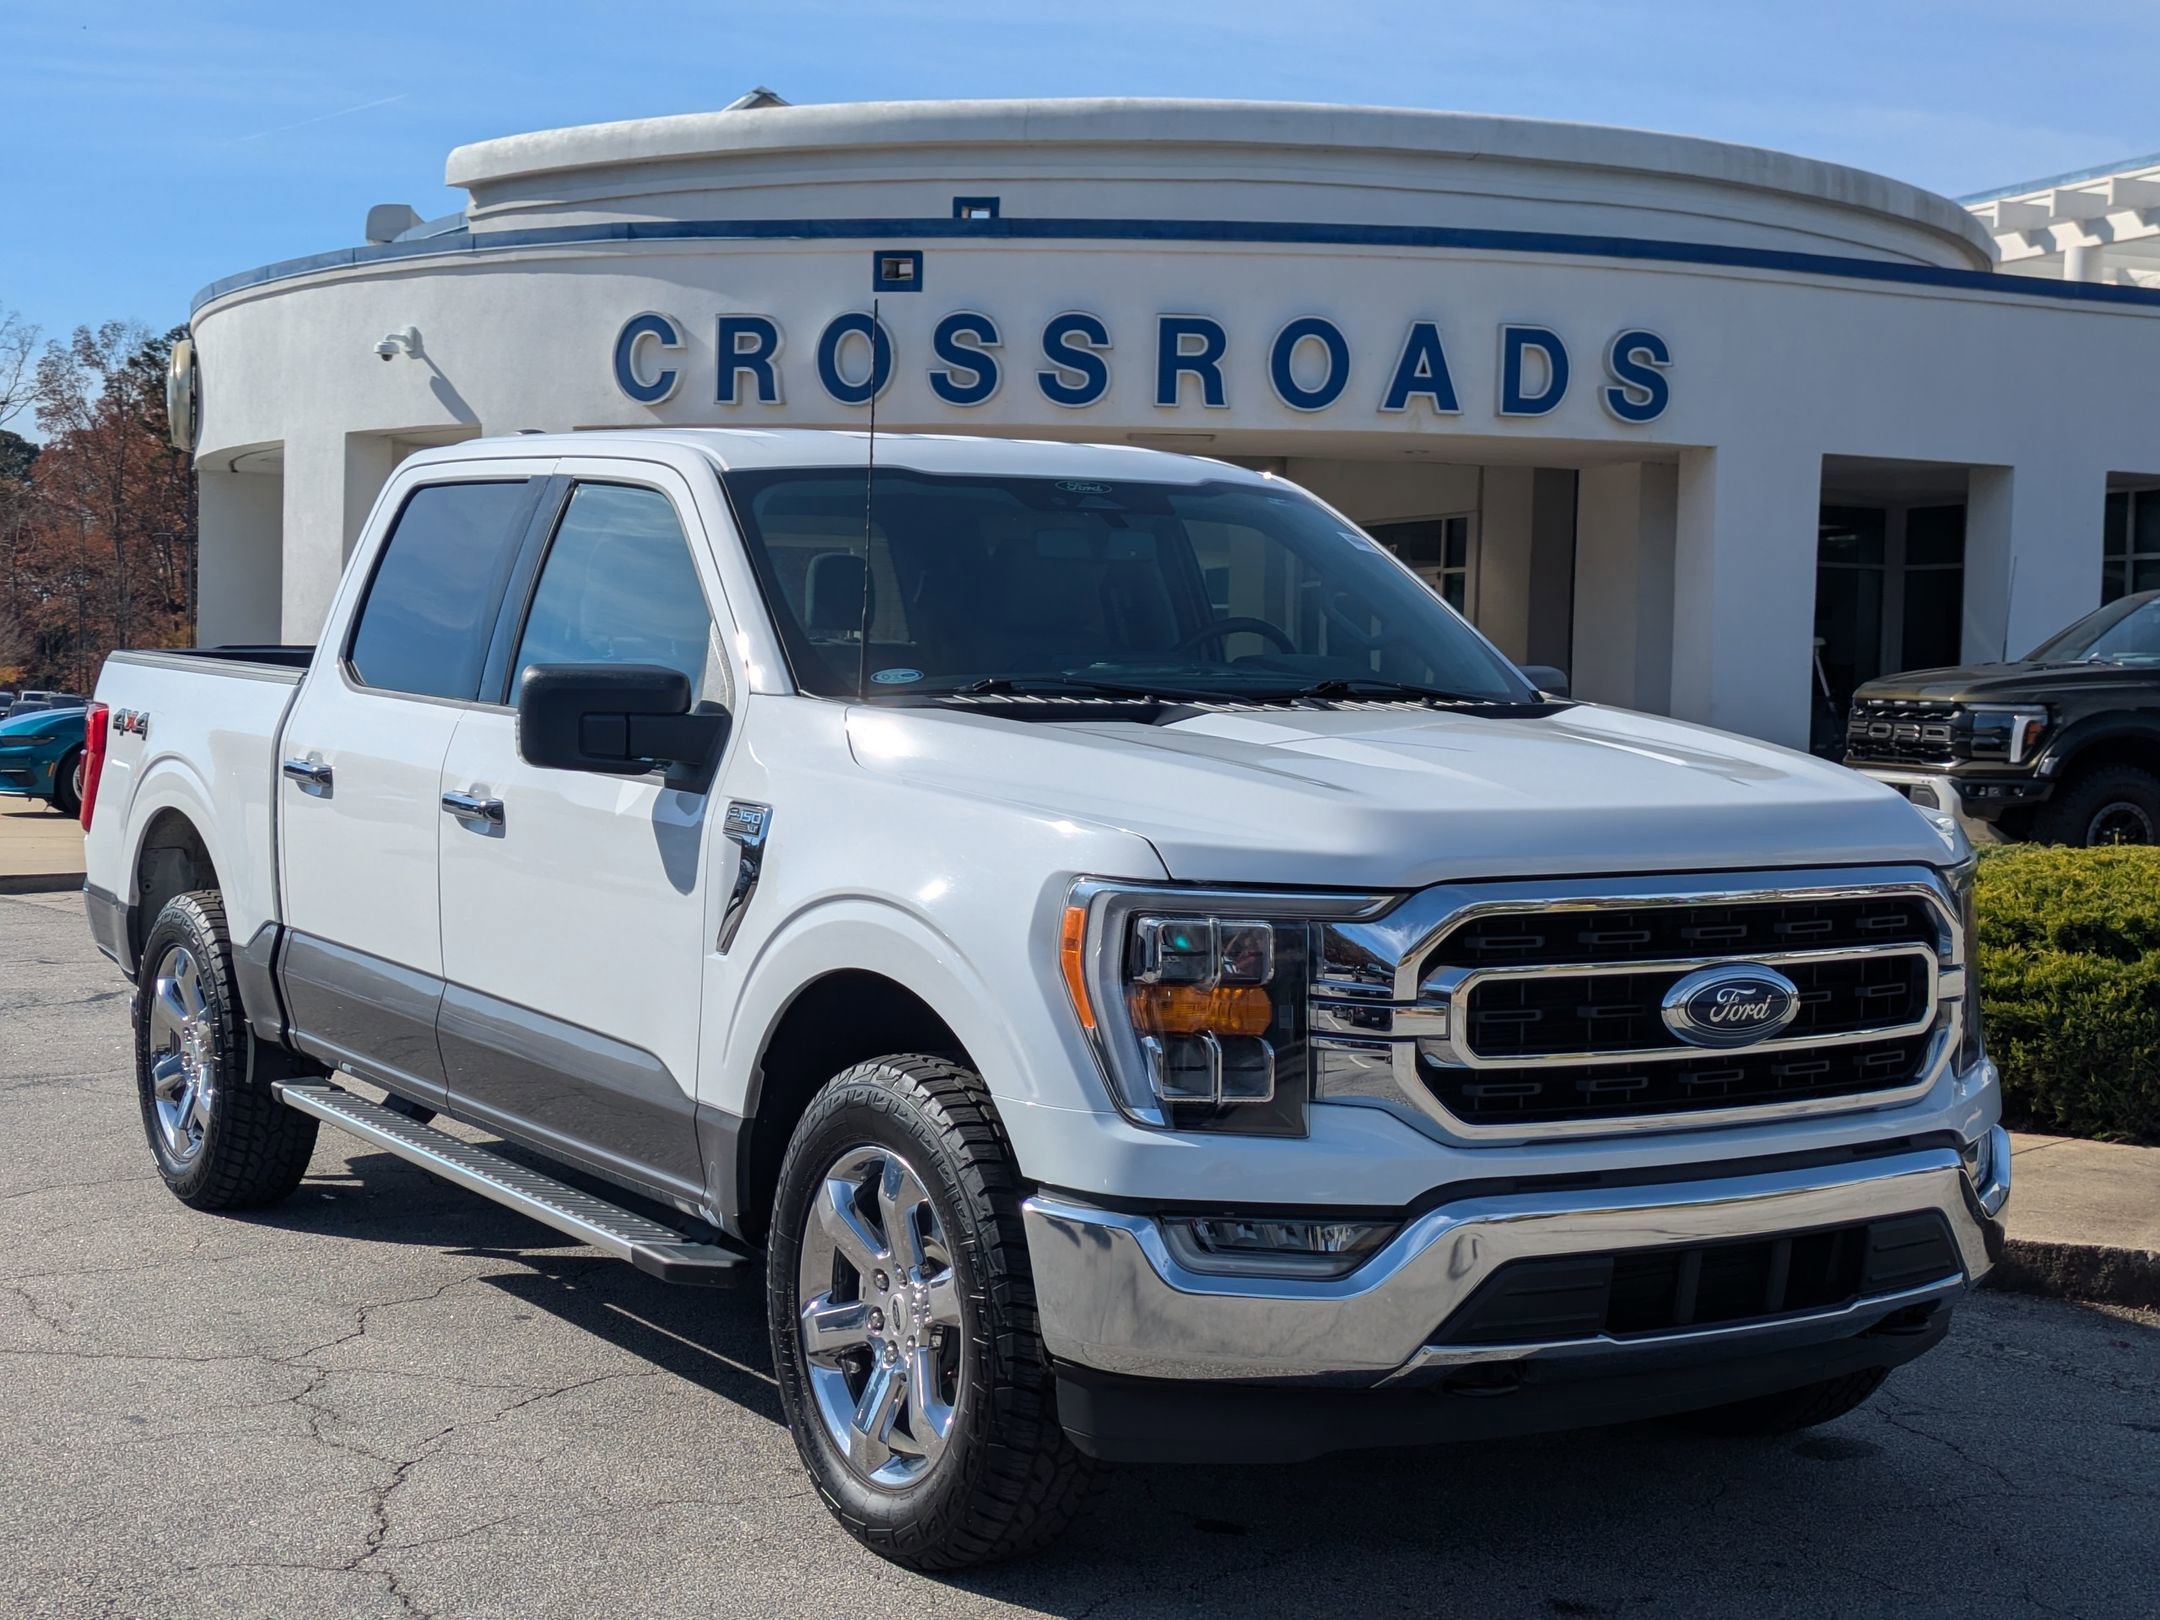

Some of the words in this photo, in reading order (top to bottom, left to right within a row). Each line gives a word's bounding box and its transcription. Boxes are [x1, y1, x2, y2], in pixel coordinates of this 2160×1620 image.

[613, 312, 1673, 424] CROSSROADS
[1847, 721, 1951, 742] FORD
[1709, 988, 1772, 1022] Ford
